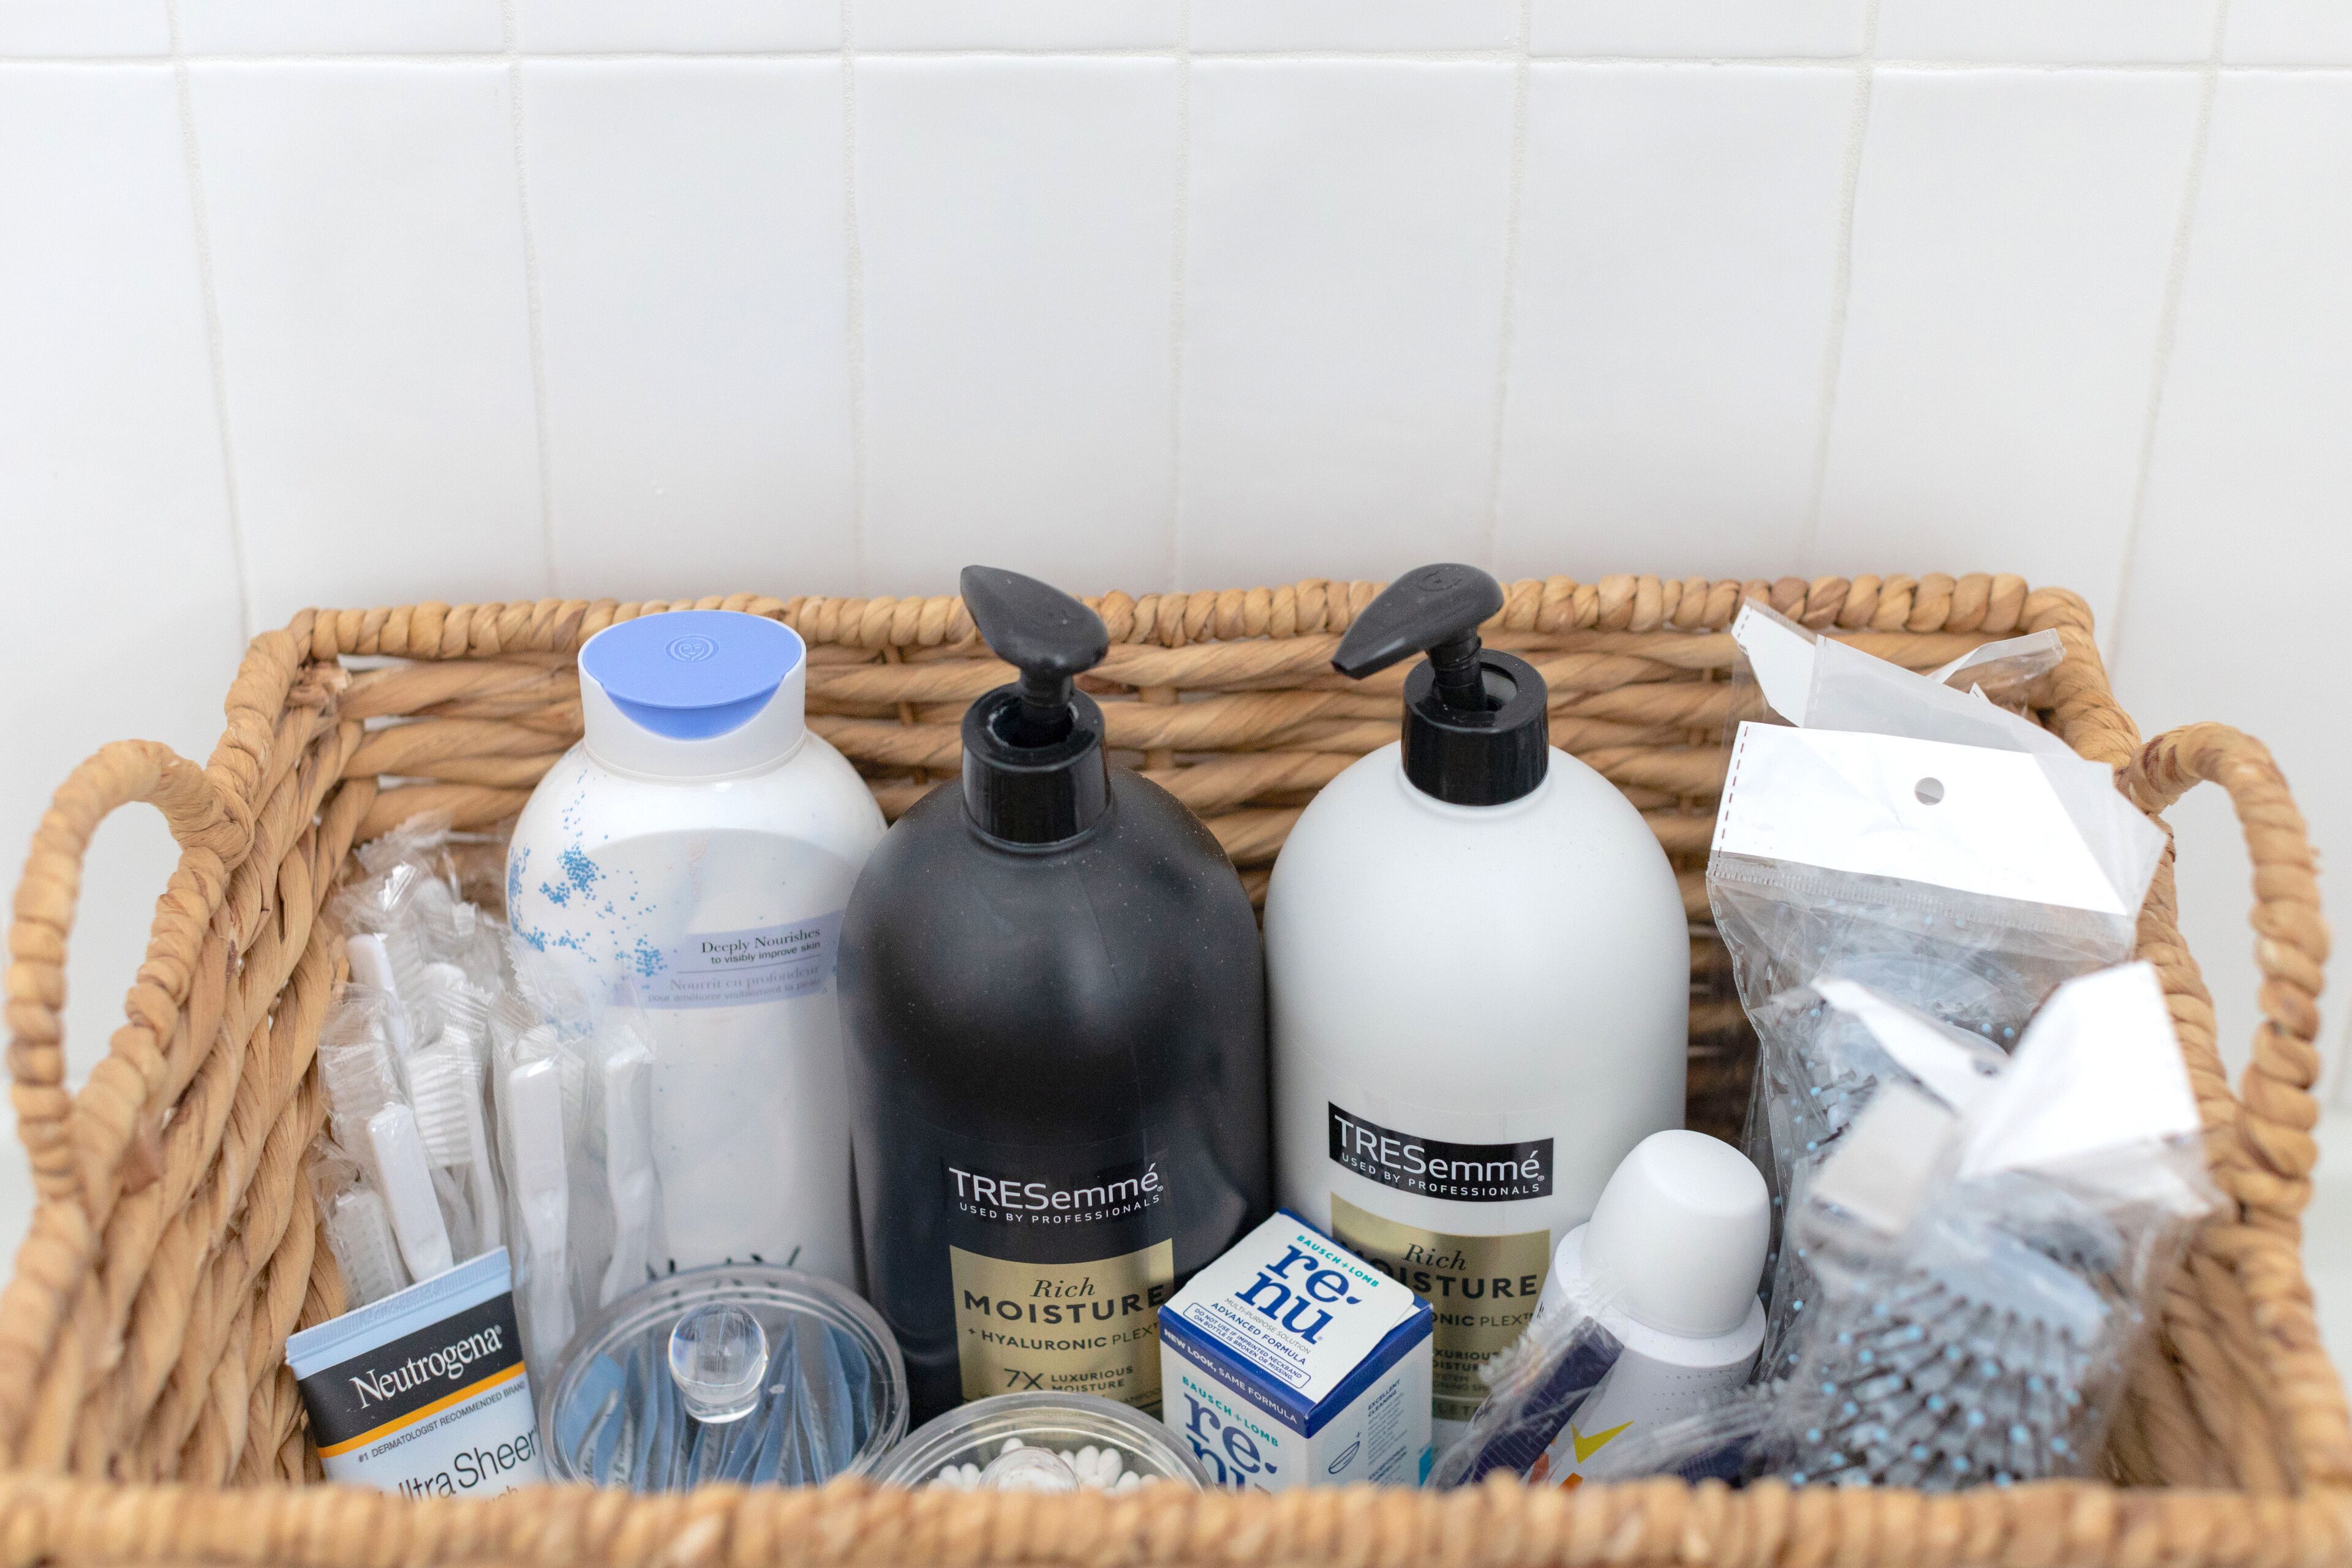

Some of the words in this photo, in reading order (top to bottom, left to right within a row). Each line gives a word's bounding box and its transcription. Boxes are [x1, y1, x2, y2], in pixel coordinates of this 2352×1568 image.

[701, 940, 750, 955] Deeply
[755, 928, 821, 948] Nourishes
[711, 956, 721, 964] to
[725, 952, 756, 962] visibly
[759, 948, 797, 960] improve
[801, 941, 821, 952] skin
[1342, 1152, 1376, 1175] USED
[1384, 1172, 1401, 1183] BY
[1409, 1178, 1540, 1196] PROFESSIONALS
[959, 1202, 997, 1219] USED
[1006, 1213, 1023, 1223] BY
[1032, 1194, 1160, 1224] PROFESSIONALS
[1402, 1243, 1467, 1271] Rich
[963, 1284, 1165, 1324] MOISTURE
[1030, 1277, 1095, 1298] Rich
[981, 1330, 1107, 1351] HYALURONIC
[1211, 1302, 1261, 1335] ADVANCED
[1262, 1333, 1306, 1365] FORMULA
[1225, 1298, 1276, 1333] MULTI-PURPOSE
[1276, 1330, 1311, 1355] SOLUTION
[1204, 1314, 1218, 1324] NOT
[1218, 1322, 1230, 1333] USE
[1237, 1333, 1268, 1357] IMPRINTED
[1268, 1352, 1302, 1379] NECKBAND
[1204, 1321, 1226, 1336] BOTTLE
[1233, 1339, 1258, 1358] BROKEN
[1258, 1355, 1268, 1363] OR
[1268, 1362, 1294, 1381] MISSING.
[1003, 1368, 1044, 1391] 7X
[1050, 1365, 1133, 1383] LUXURIOUS
[1164, 1328, 1186, 1348] NEW
[1187, 1346, 1218, 1373] LOOK,
[1218, 1367, 1246, 1391] SAME
[1248, 1385, 1297, 1424] FORMULA
[1368, 1378, 1401, 1411] EXCELLENT
[1368, 1389, 1397, 1417] CLEANING
[358, 1452, 369, 1463] #1
[371, 1420, 439, 1458] DERMATOLOGIST
[439, 1392, 503, 1427] RECOMMENDED
[454, 1430, 537, 1488] Sheer
